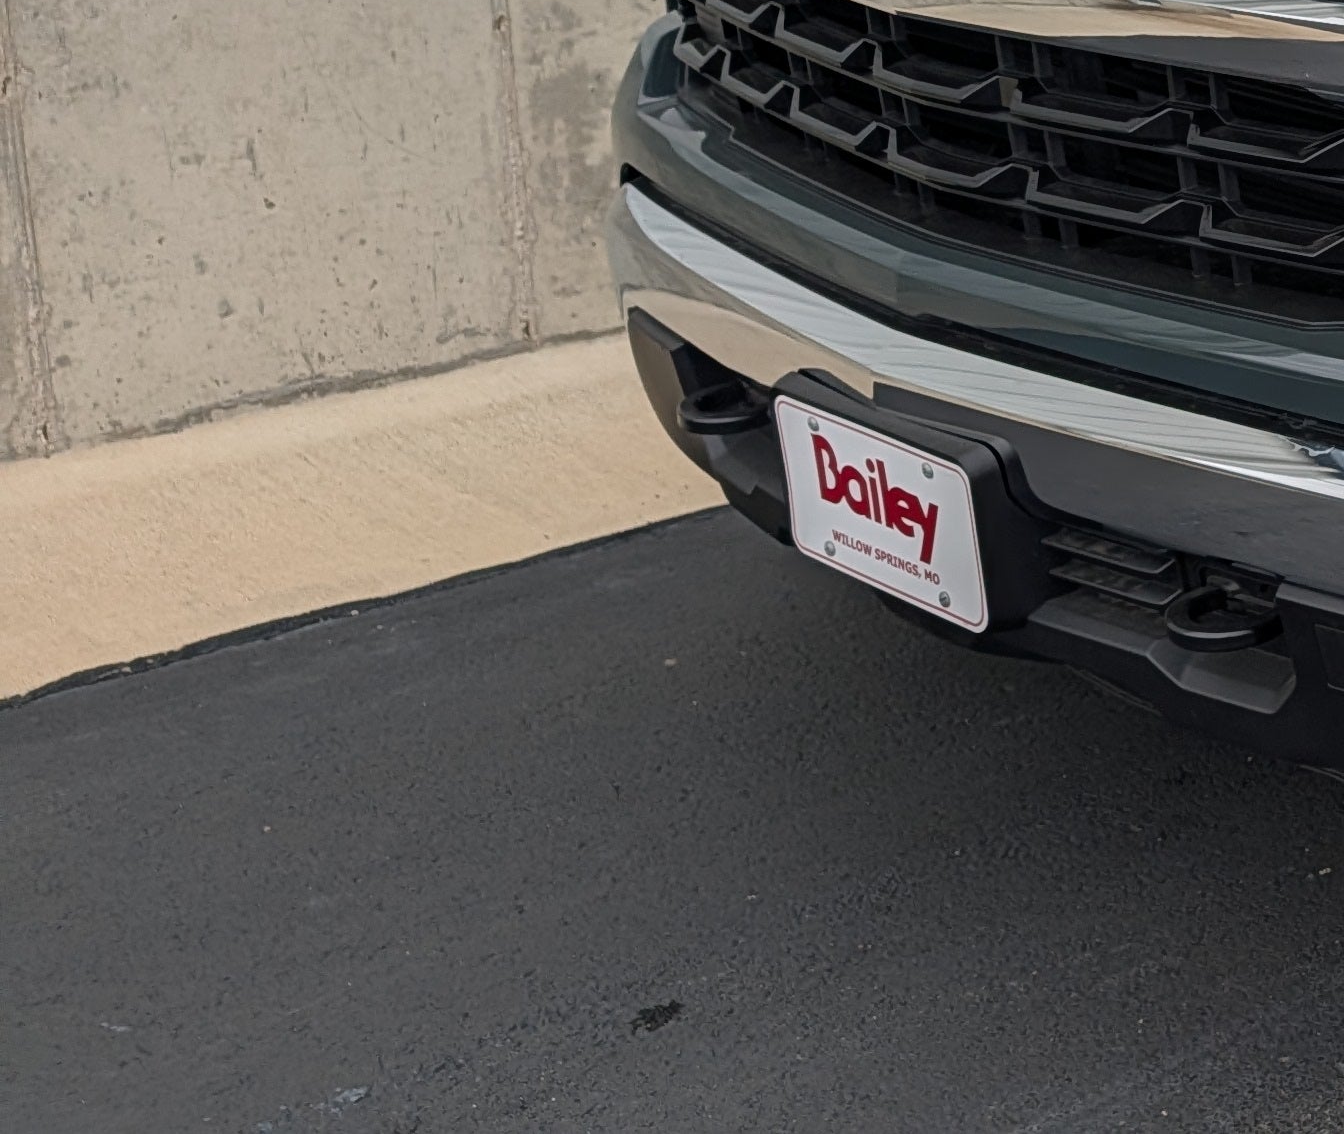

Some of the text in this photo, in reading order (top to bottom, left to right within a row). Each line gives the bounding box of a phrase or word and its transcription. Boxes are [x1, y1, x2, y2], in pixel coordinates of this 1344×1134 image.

[810, 433, 939, 564] Bailey
[832, 529, 940, 585] WILLOW SPRINGS, MO
